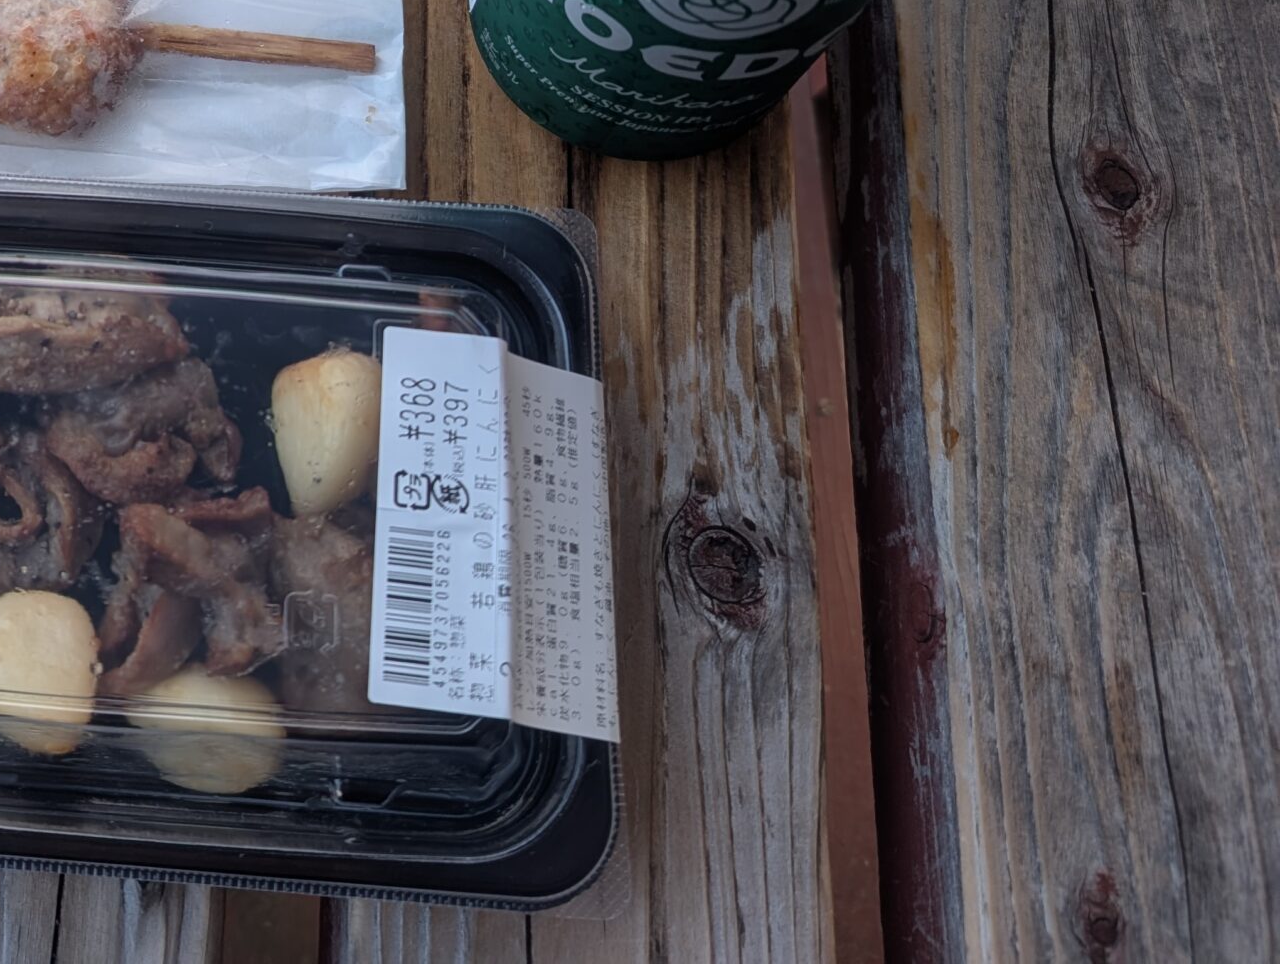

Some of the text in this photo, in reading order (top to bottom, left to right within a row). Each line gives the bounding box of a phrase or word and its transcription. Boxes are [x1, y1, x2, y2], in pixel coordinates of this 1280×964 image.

[504, 34, 539, 75] Super
[570, 84, 672, 125] SESSION
[398, 377, 437, 441] ¥368
[443, 381, 469, 445] ¥397
[432, 529, 452, 688] 4549737056226
